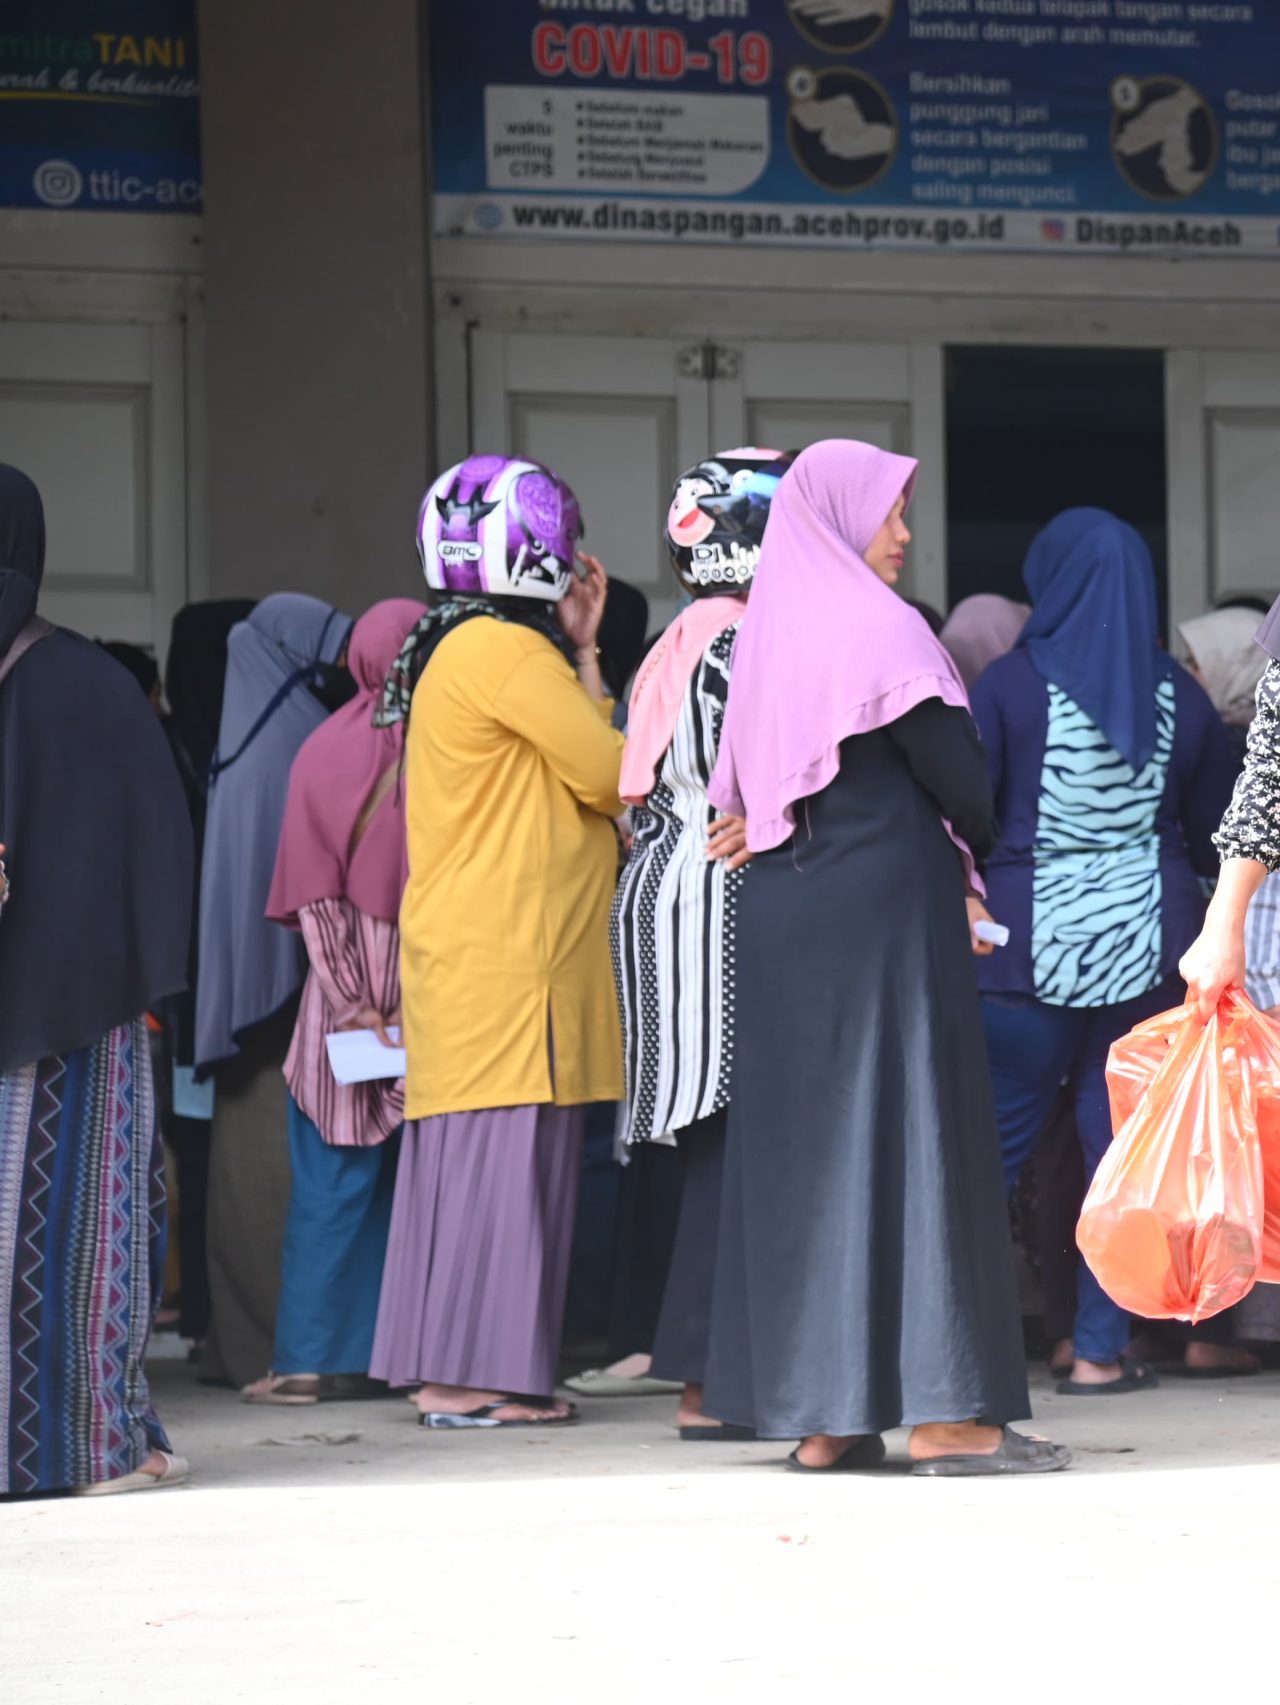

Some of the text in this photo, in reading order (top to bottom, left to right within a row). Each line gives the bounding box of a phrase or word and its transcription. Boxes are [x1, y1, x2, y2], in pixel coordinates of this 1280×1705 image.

[532, 21, 770, 84] COVID-19
[88, 169, 203, 204] ttic-ac
[512, 203, 1005, 243] www.dinaspangan.acehprov.go.id
[1075, 217, 1242, 249] DispanAceh
